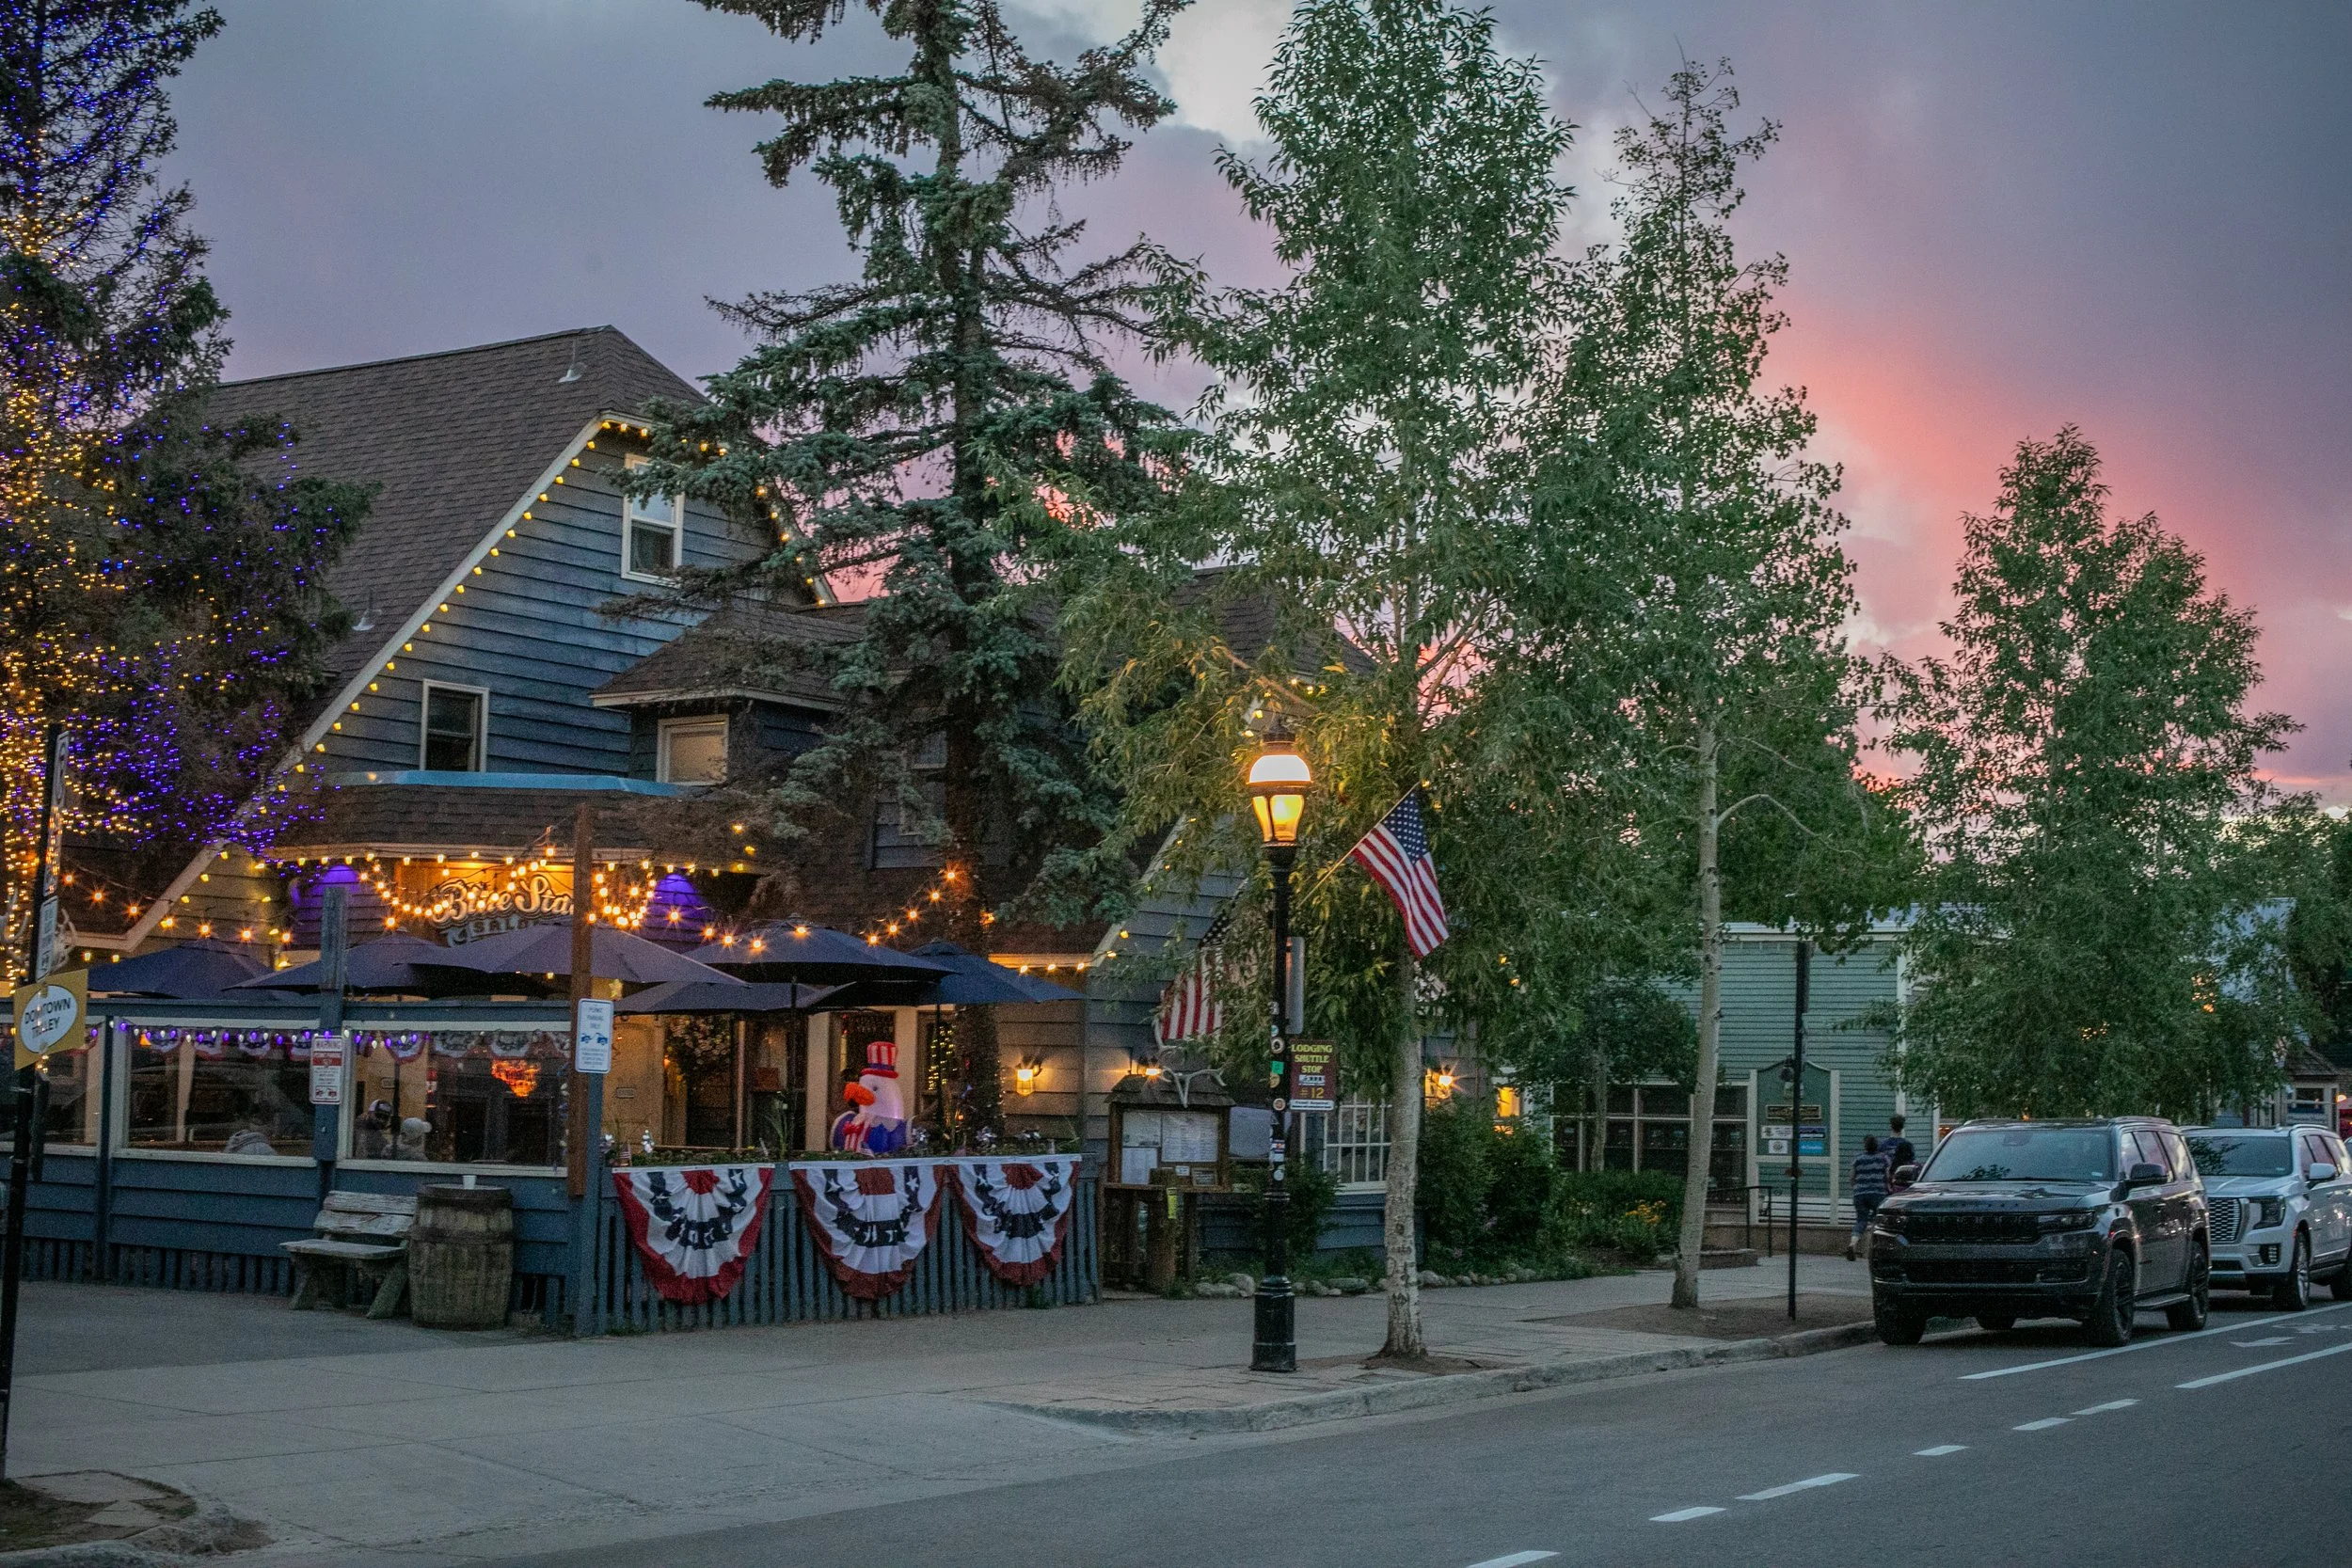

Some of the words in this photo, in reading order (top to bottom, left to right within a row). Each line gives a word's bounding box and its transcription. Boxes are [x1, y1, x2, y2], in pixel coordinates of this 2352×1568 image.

[431, 880, 514, 924] Blue
[515, 875, 575, 915] Sta
[24, 998, 72, 1024] DOTOWN
[31, 1017, 60, 1038] TRLEY
[1290, 1044, 1333, 1053] LODGING
[1294, 1054, 1330, 1063] SHUTTLE
[1301, 1065, 1323, 1073] STOP
[1298, 1087, 1325, 1099] #12
